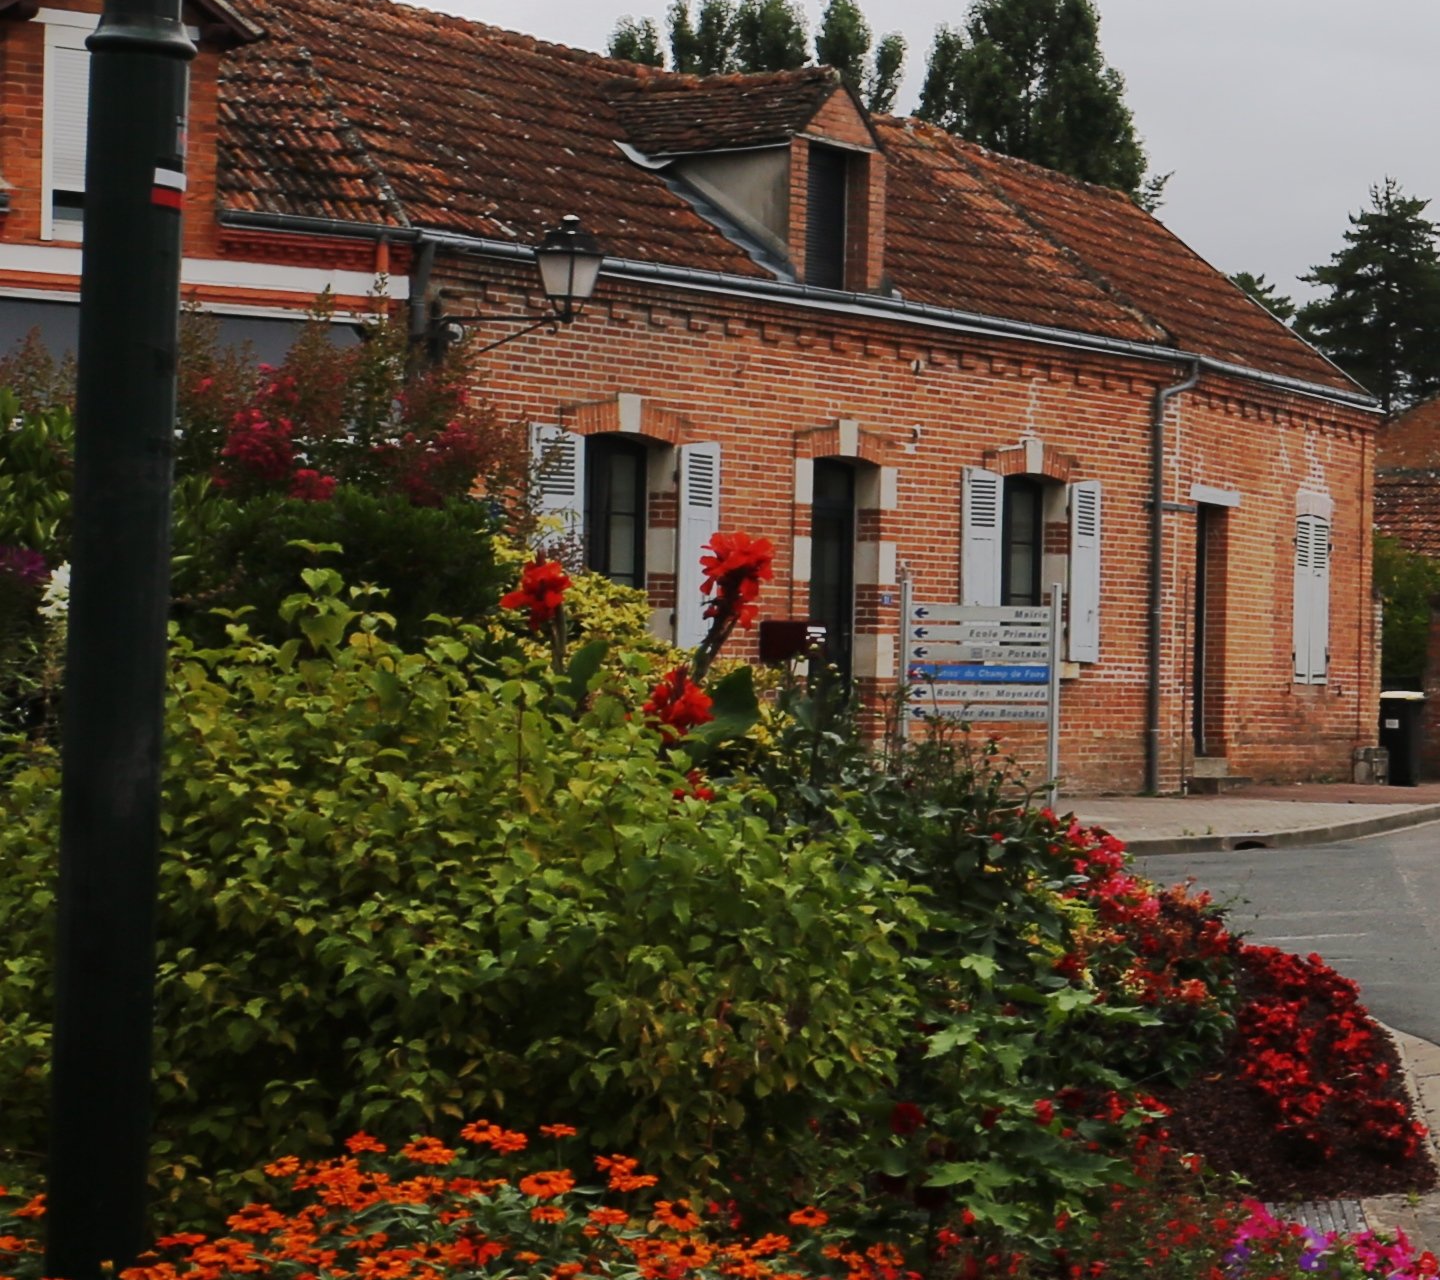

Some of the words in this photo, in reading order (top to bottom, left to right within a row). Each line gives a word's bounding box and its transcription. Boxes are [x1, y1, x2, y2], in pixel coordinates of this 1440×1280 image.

[1014, 610, 1048, 619] Mairie
[969, 629, 998, 638] Ecole
[1003, 630, 1047, 639] Primaire
[1007, 650, 1047, 658] Potable
[937, 689, 967, 697] Route
[978, 709, 995, 717] des
